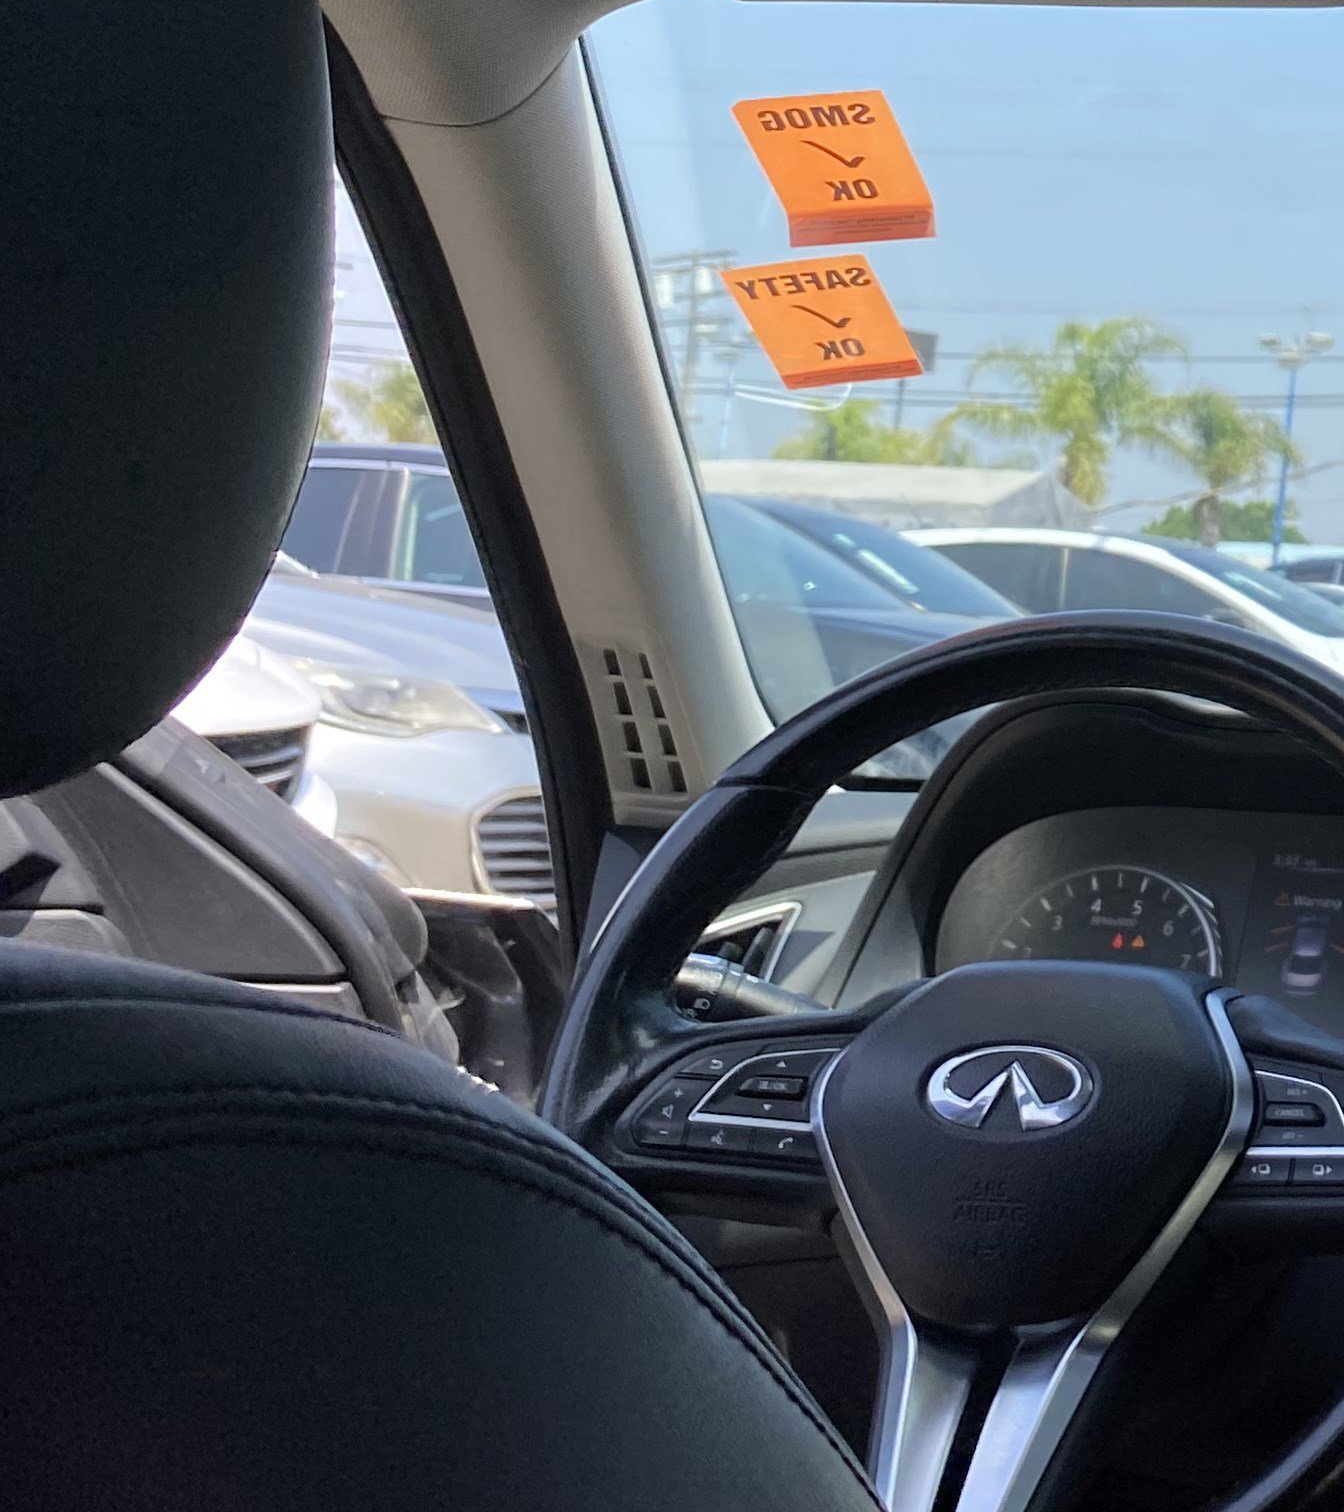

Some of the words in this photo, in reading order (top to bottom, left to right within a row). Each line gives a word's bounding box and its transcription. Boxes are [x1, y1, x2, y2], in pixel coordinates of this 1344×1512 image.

[1089, 898, 1102, 913] 4
[1131, 899, 1144, 915] 5
[1293, 895, 1343, 911] Warning
[1052, 915, 1063, 930] 3
[1162, 920, 1175, 936] 6
[1180, 953, 1192, 969] 7
